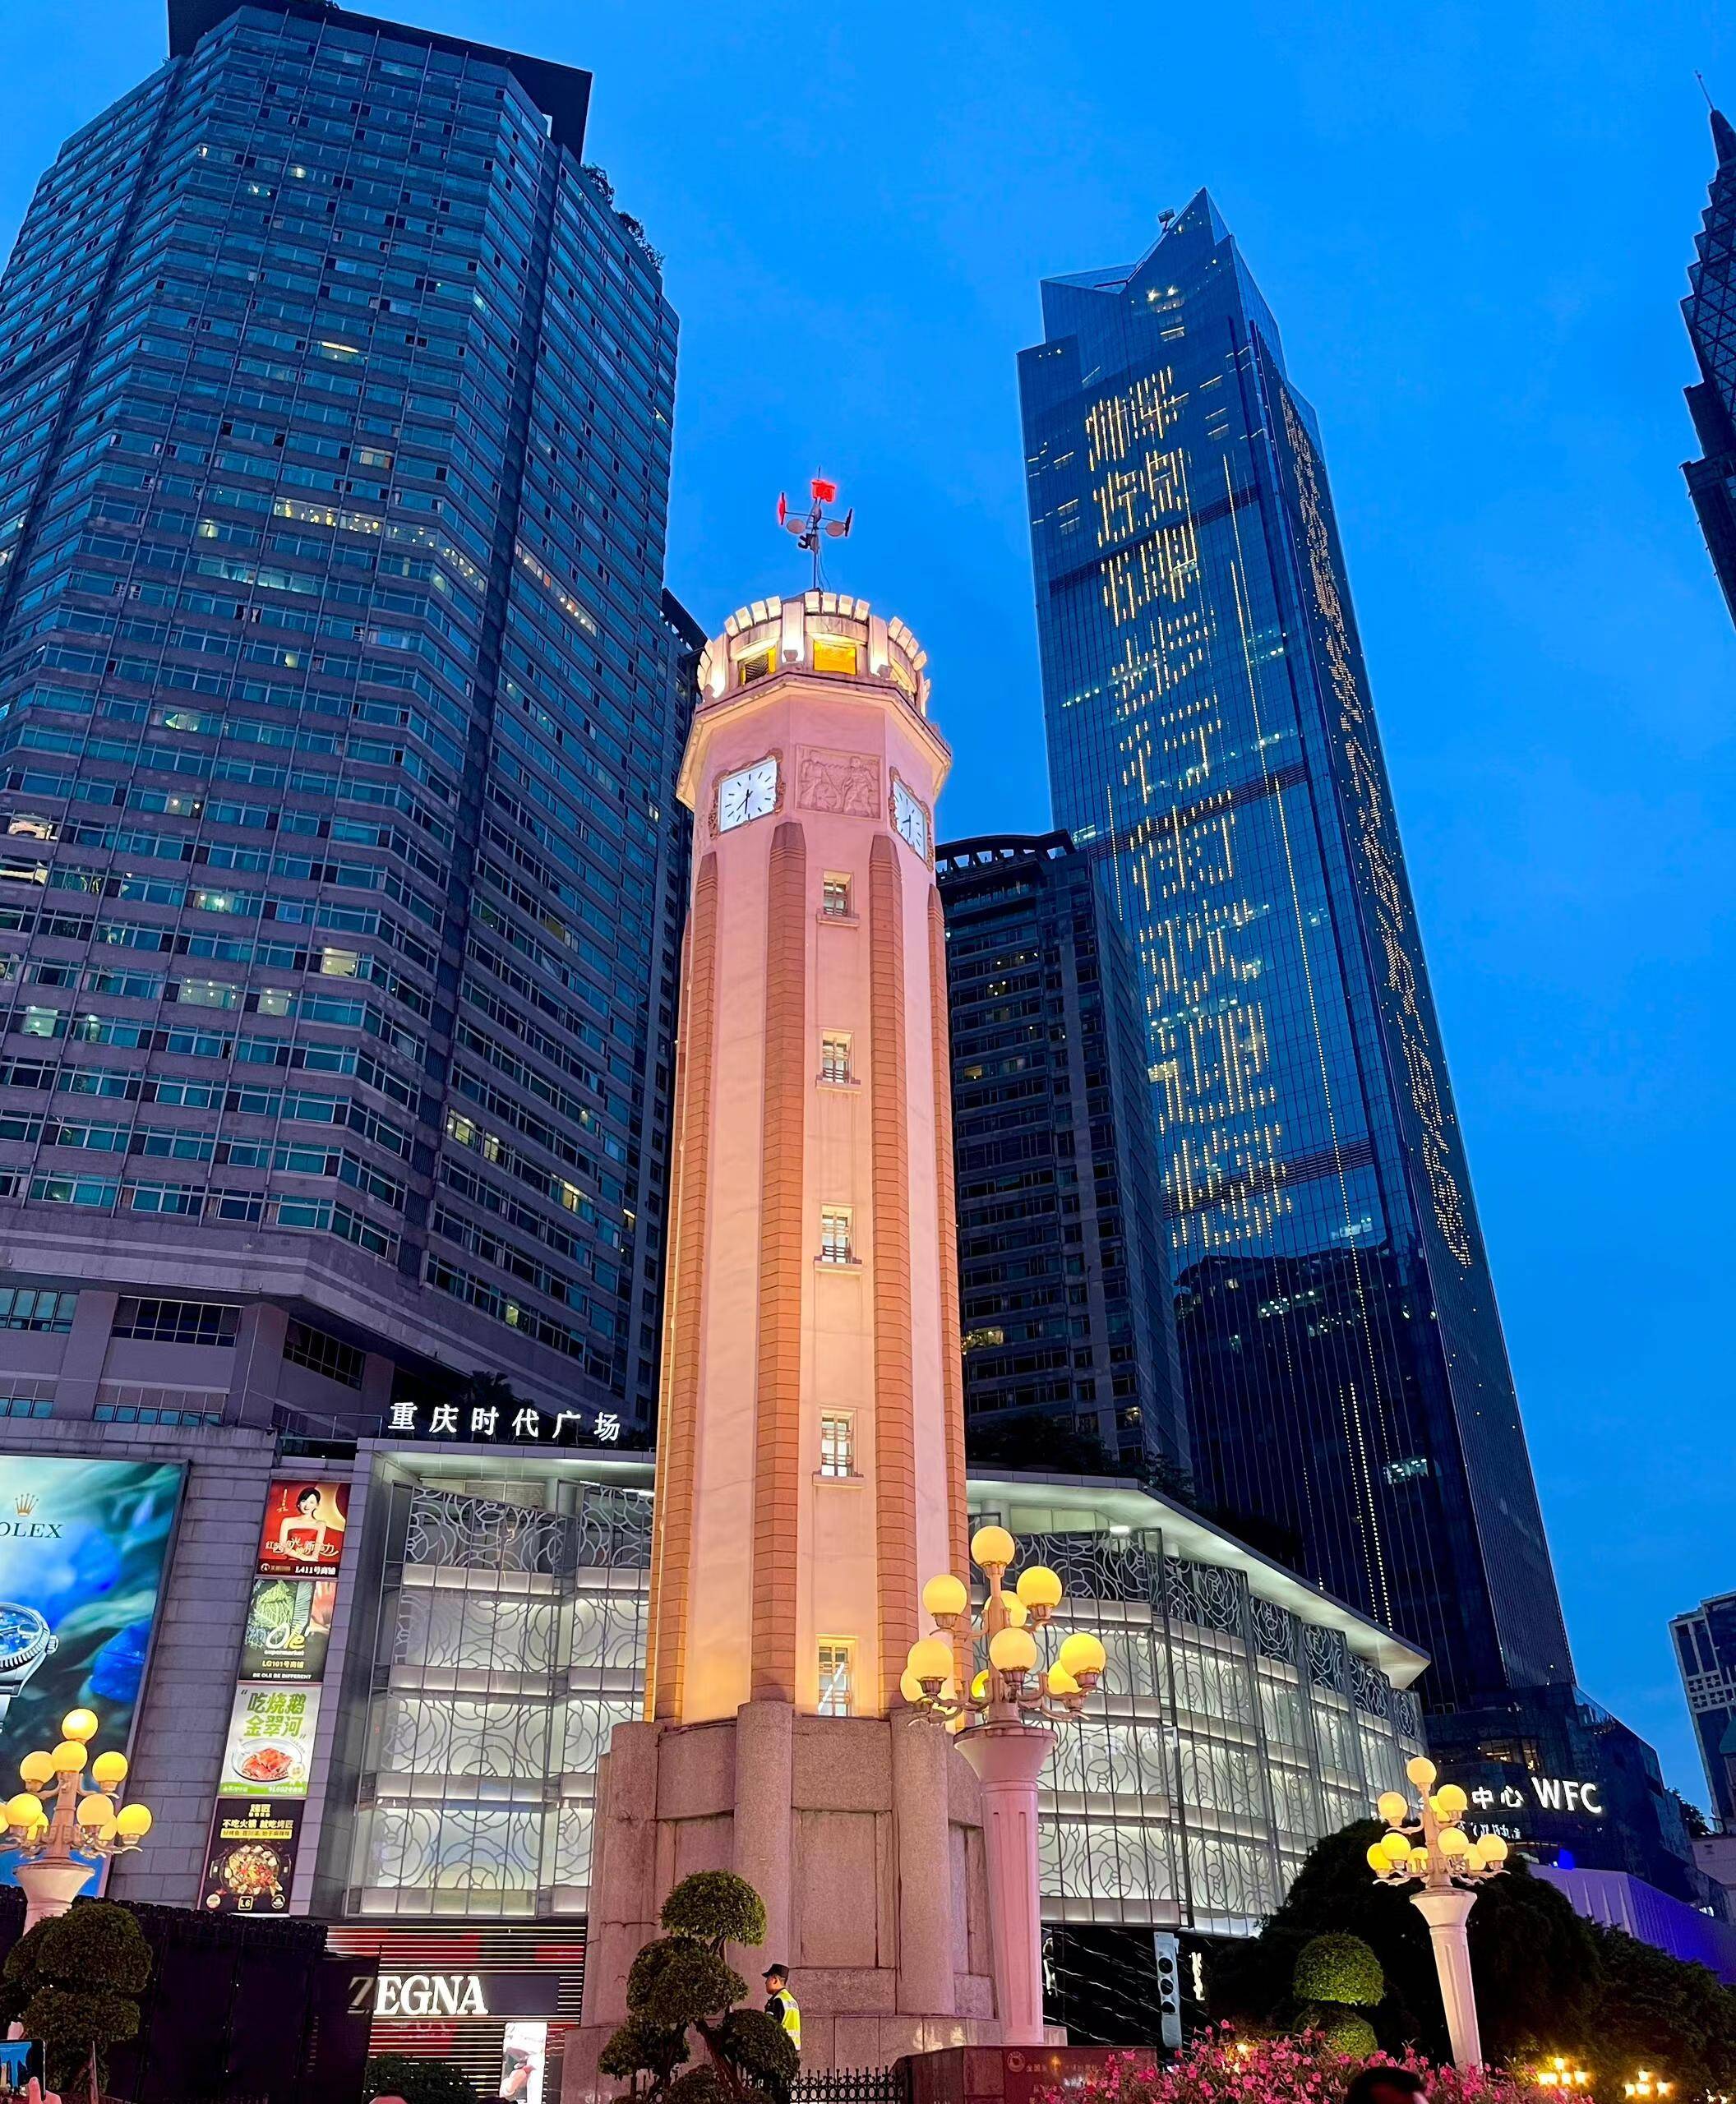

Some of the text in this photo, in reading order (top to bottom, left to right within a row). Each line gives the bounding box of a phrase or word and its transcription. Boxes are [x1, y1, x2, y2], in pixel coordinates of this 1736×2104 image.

[387, 1400, 621, 1442] 重庆时代广场
[1531, 1775, 1604, 1815] WFC
[240, 1899, 251, 1908] L6
[347, 1974, 489, 2016] ZEGNA
